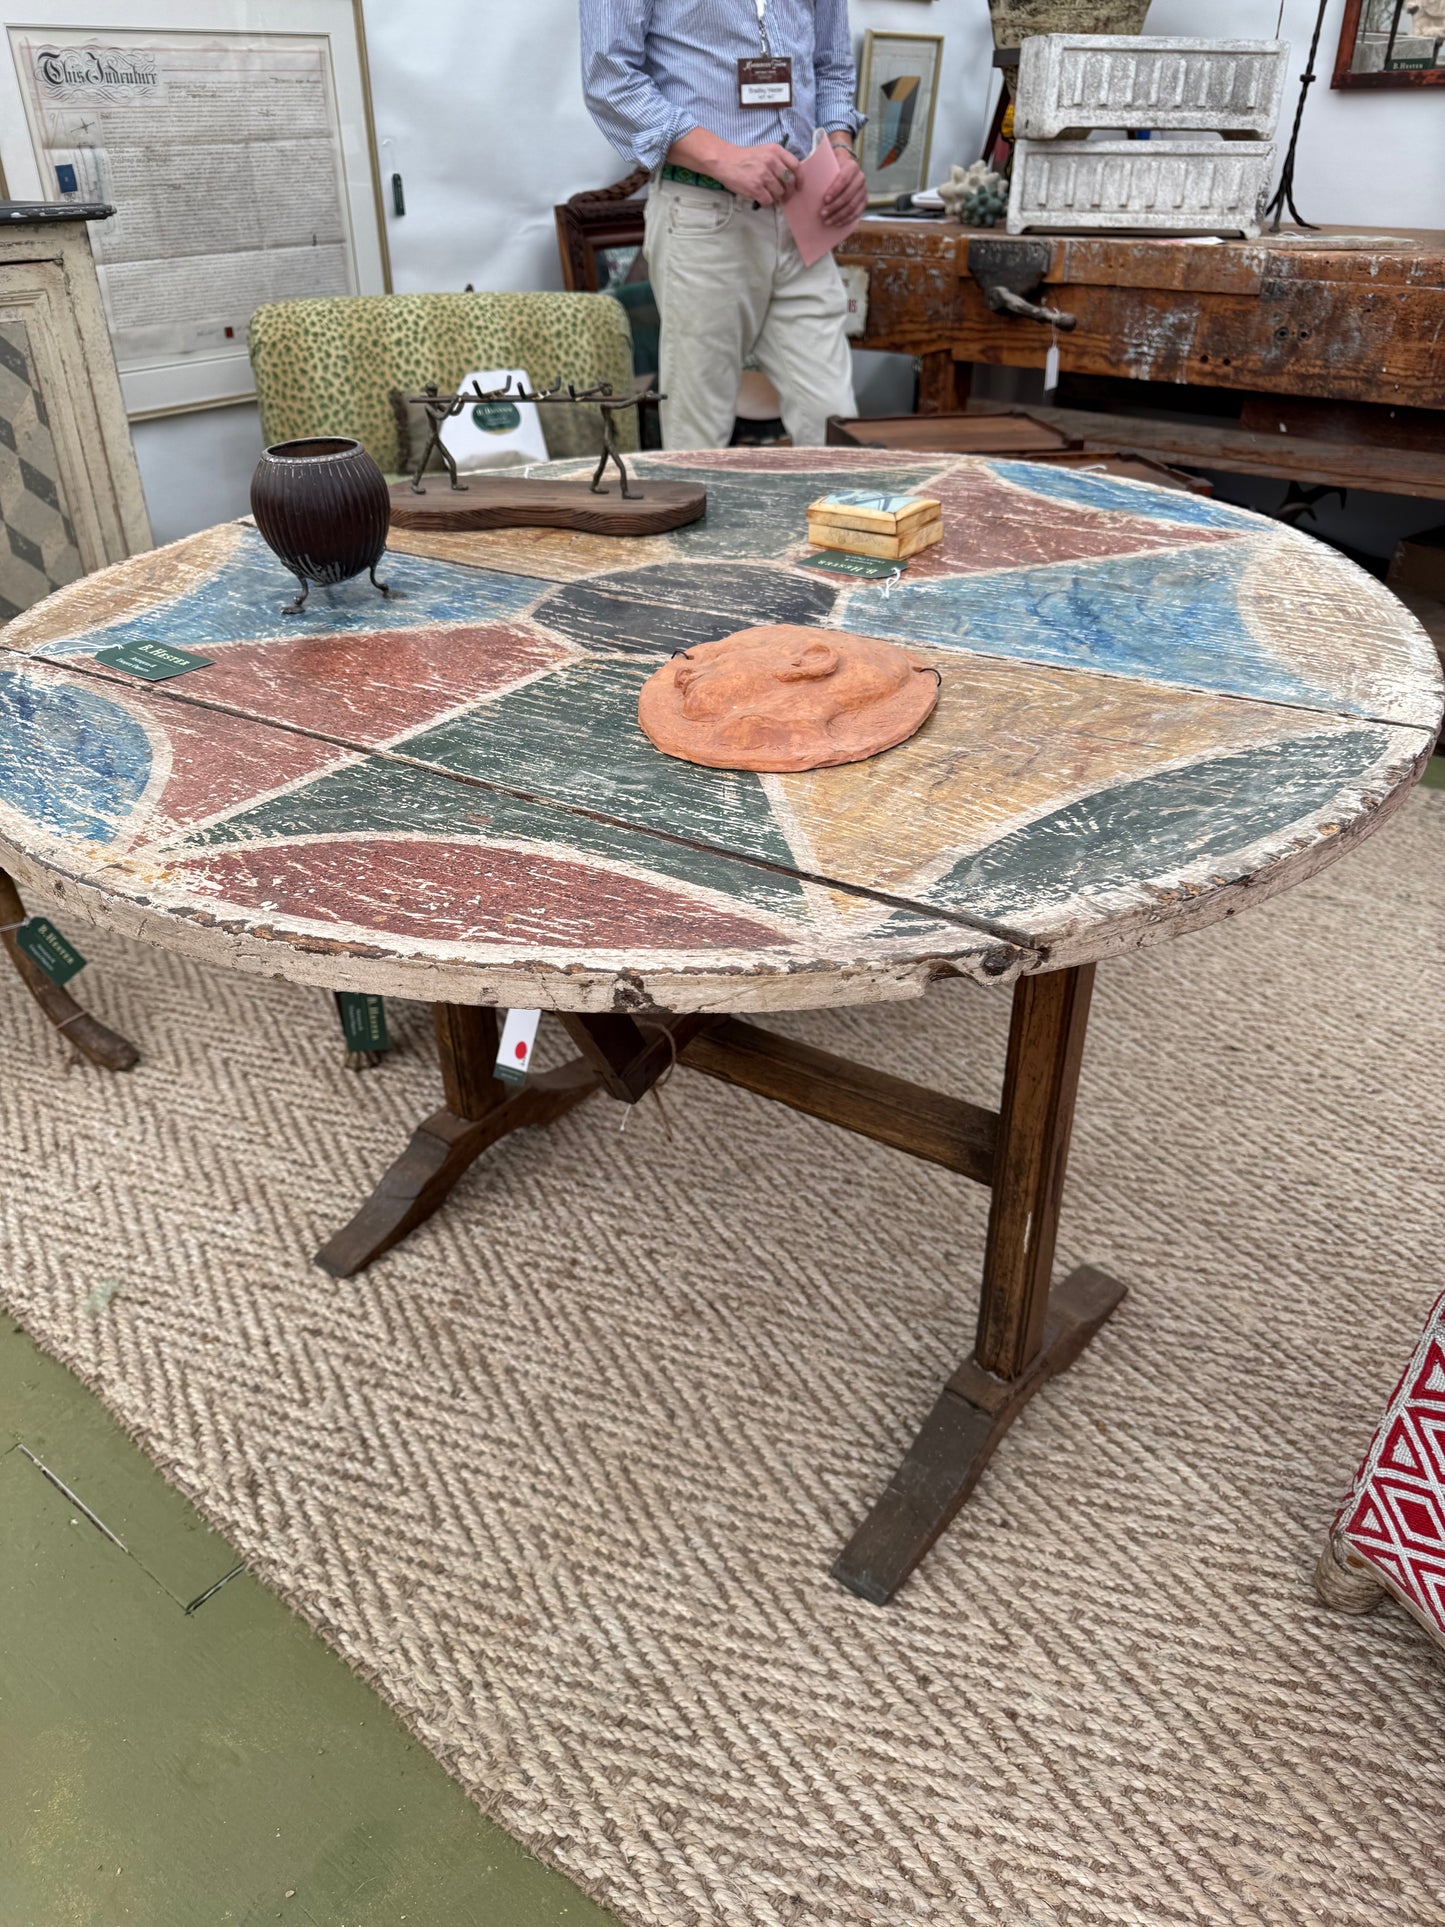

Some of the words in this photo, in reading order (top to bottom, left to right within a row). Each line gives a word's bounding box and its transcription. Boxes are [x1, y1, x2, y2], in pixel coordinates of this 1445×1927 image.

[38, 52, 86, 85] This
[86, 52, 158, 85] Indenture
[818, 560, 864, 572] HESTER
[148, 648, 191, 666] HESTER
